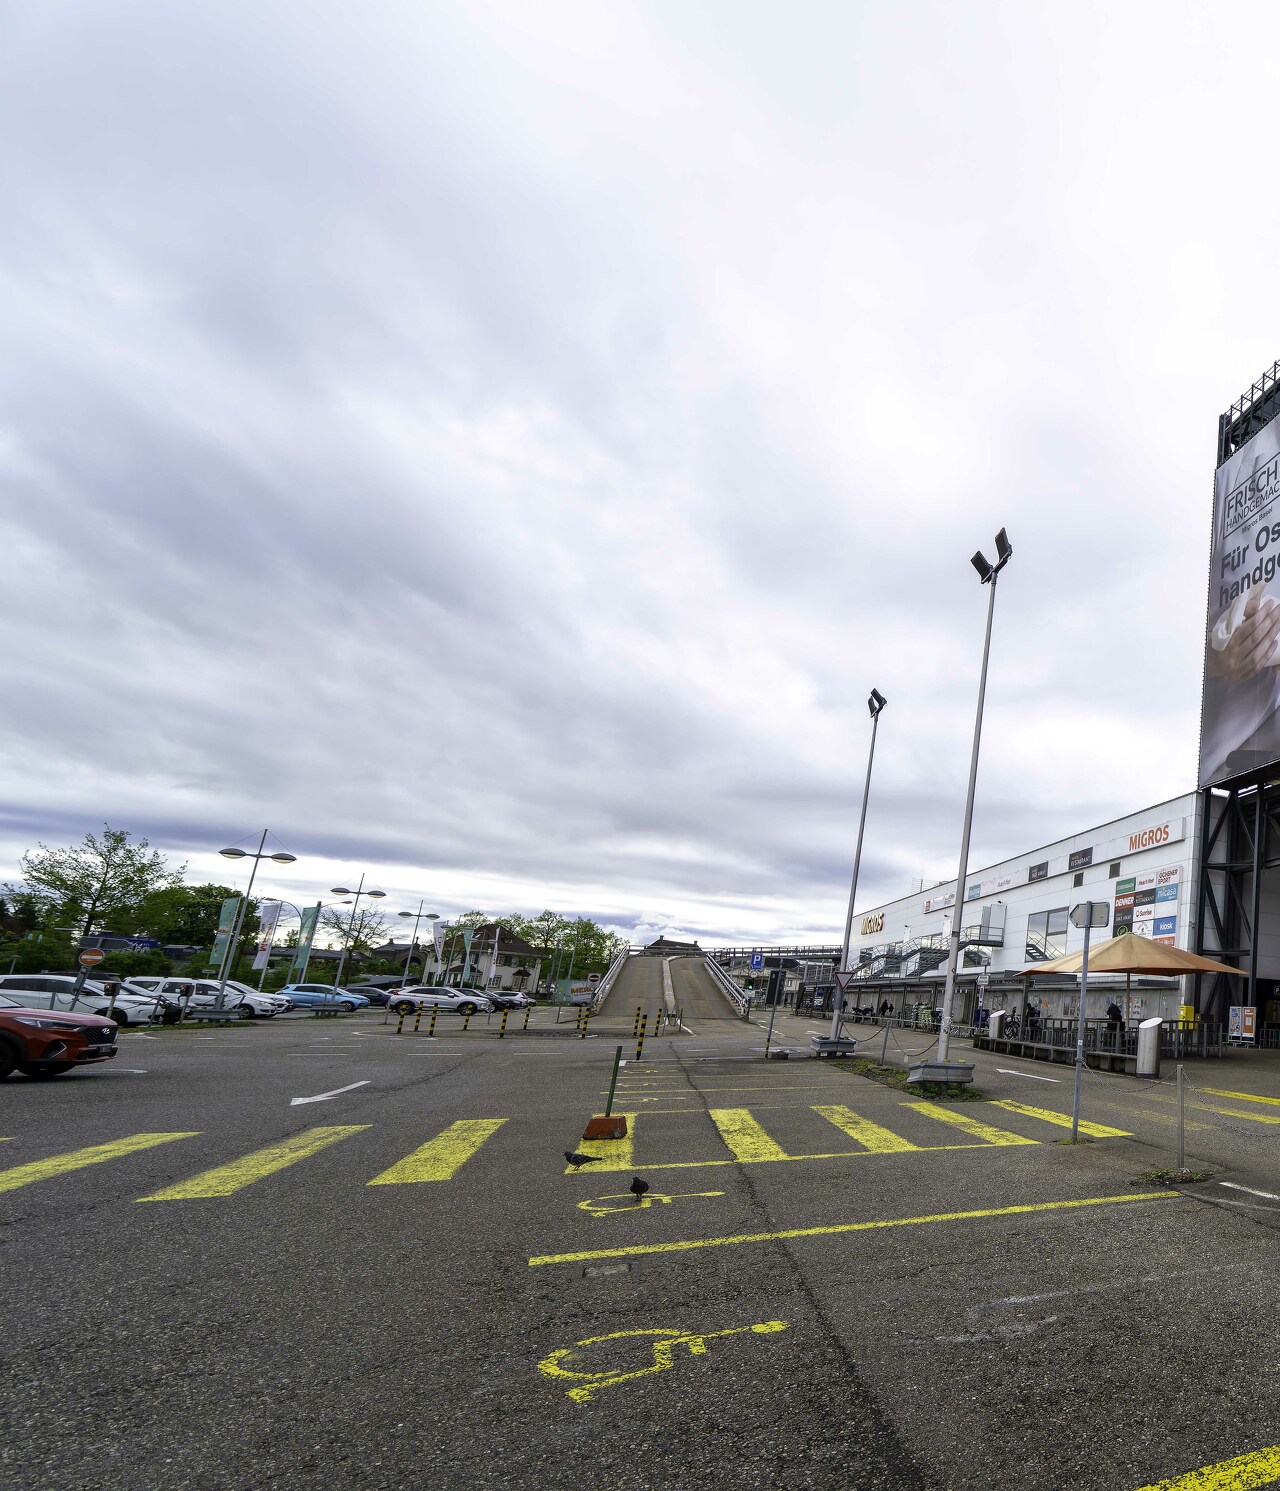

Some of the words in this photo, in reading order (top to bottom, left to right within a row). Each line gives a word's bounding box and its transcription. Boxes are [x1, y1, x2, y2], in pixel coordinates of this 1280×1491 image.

[1226, 461, 1278, 519] FRISCH
[1241, 519, 1259, 535] Migros
[1259, 506, 1273, 521] Basel
[1220, 545, 1250, 580] Für
[1129, 824, 1170, 852] MIGROS
[1158, 868, 1179, 879] OCHSNER
[1157, 876, 1171, 885] SPORT
[1157, 885, 1177, 898] micasa
[1115, 896, 1135, 907] DENNER
[1139, 909, 1152, 917] Sunrise
[753, 955, 761, 965] P
